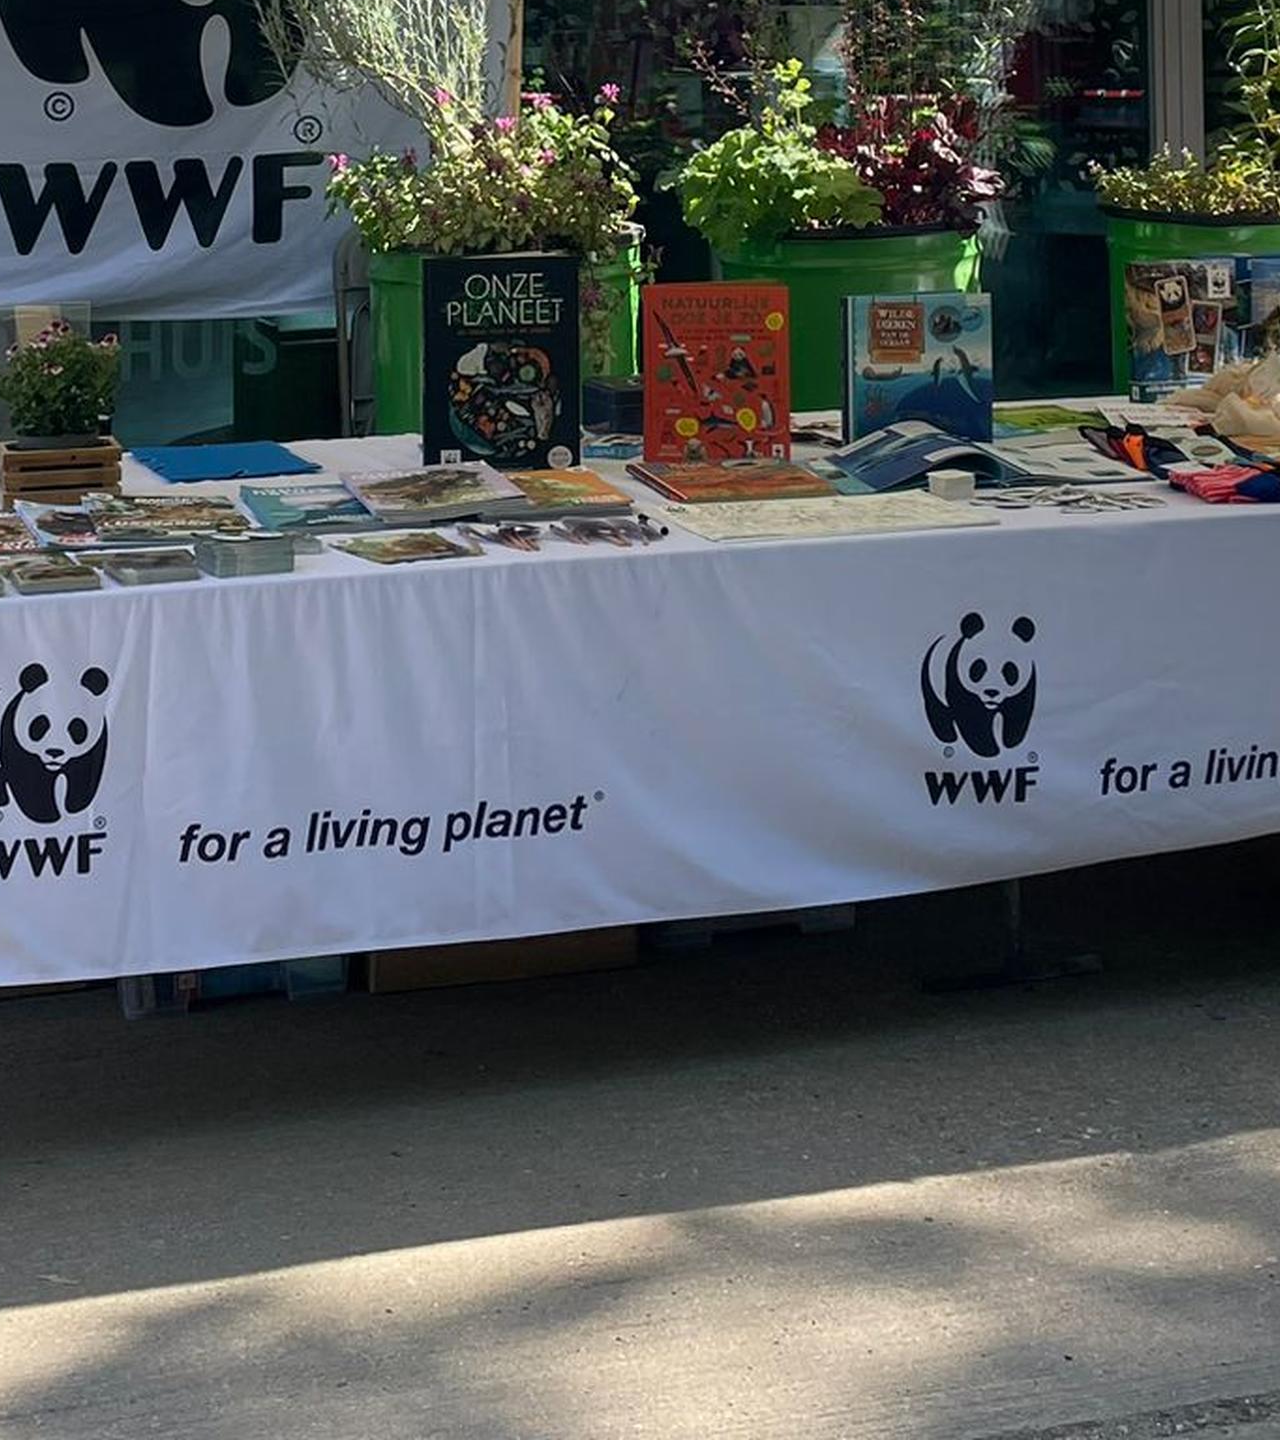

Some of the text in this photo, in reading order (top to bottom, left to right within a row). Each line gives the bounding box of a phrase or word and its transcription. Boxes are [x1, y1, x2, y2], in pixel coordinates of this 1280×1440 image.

[464, 272, 545, 300] ONZE
[446, 298, 564, 327] PLANEET
[925, 766, 1040, 806] WWF
[1100, 758, 1157, 796] for
[1168, 760, 1192, 790] a
[178, 792, 588, 864] for a living planet
